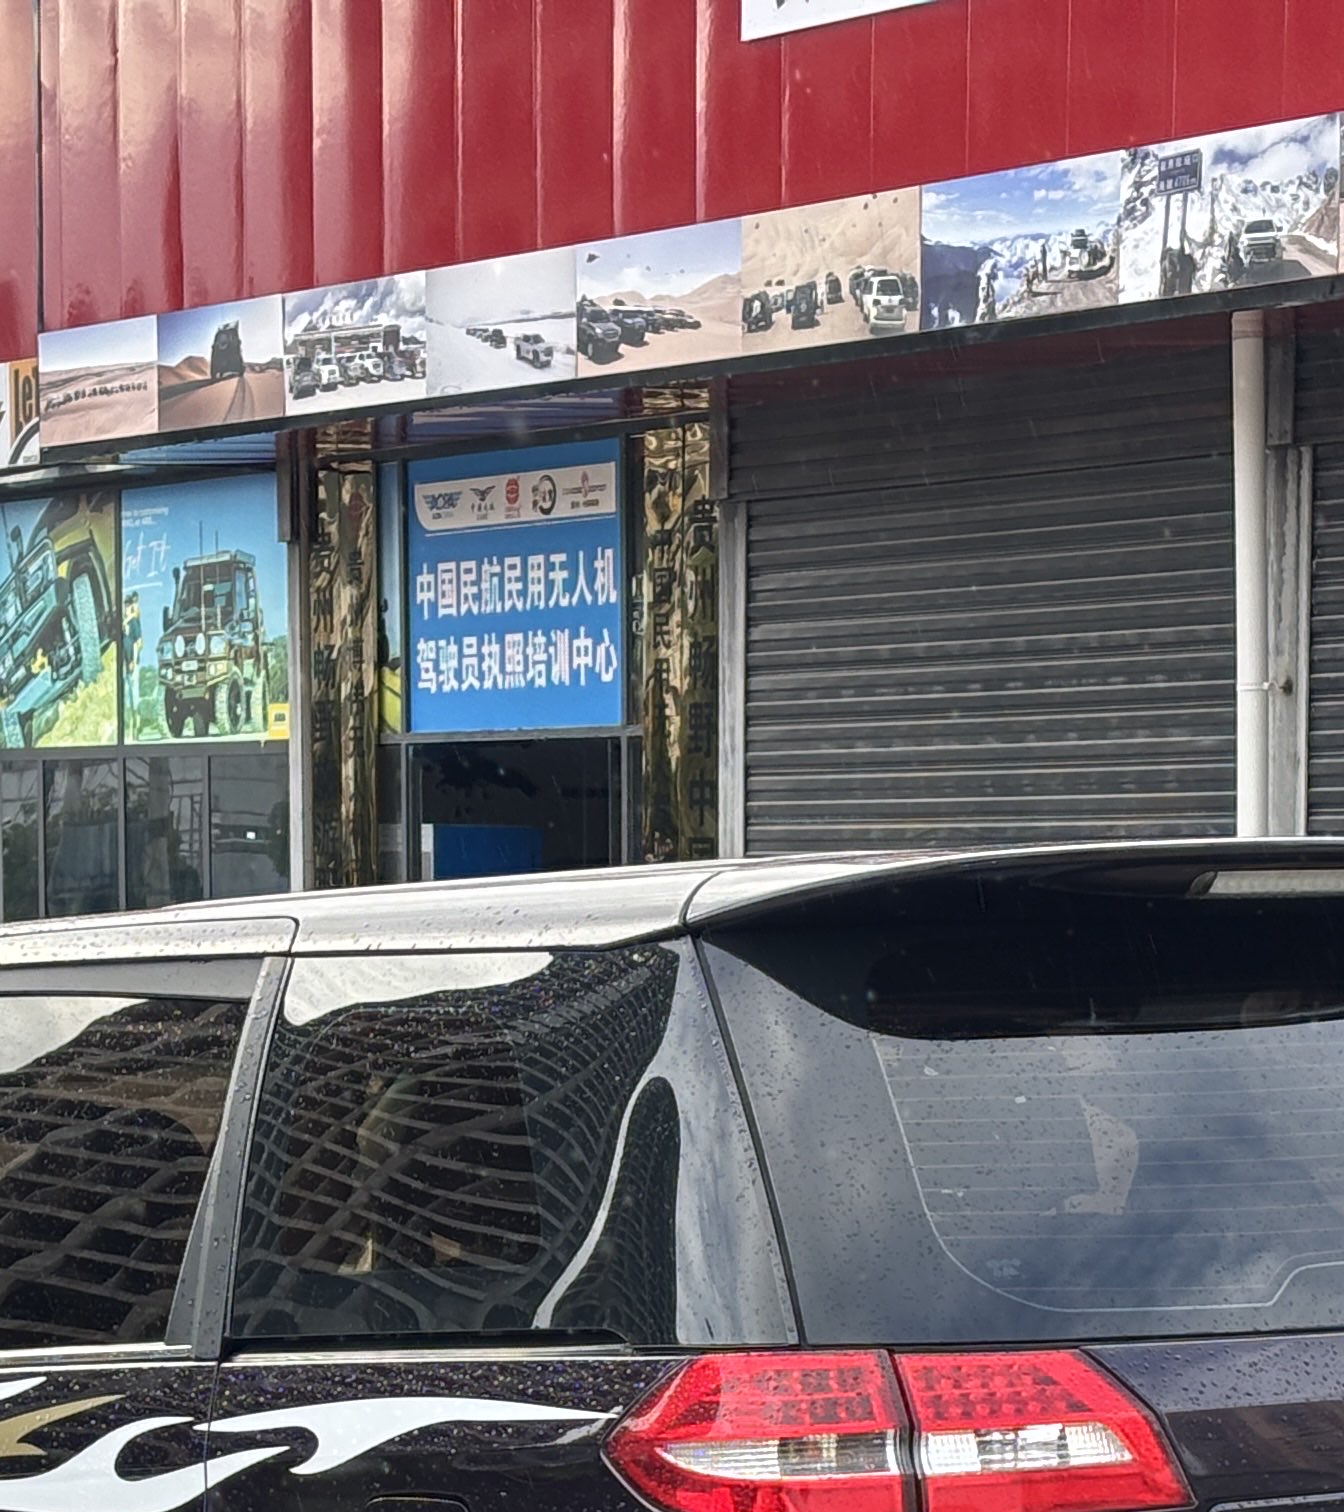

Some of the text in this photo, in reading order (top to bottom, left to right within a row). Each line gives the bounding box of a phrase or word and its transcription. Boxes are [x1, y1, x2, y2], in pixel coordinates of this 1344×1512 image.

[416, 547, 618, 620] 中国民航民用无人机
[416, 626, 619, 694] 驾驶员执照培训中心
